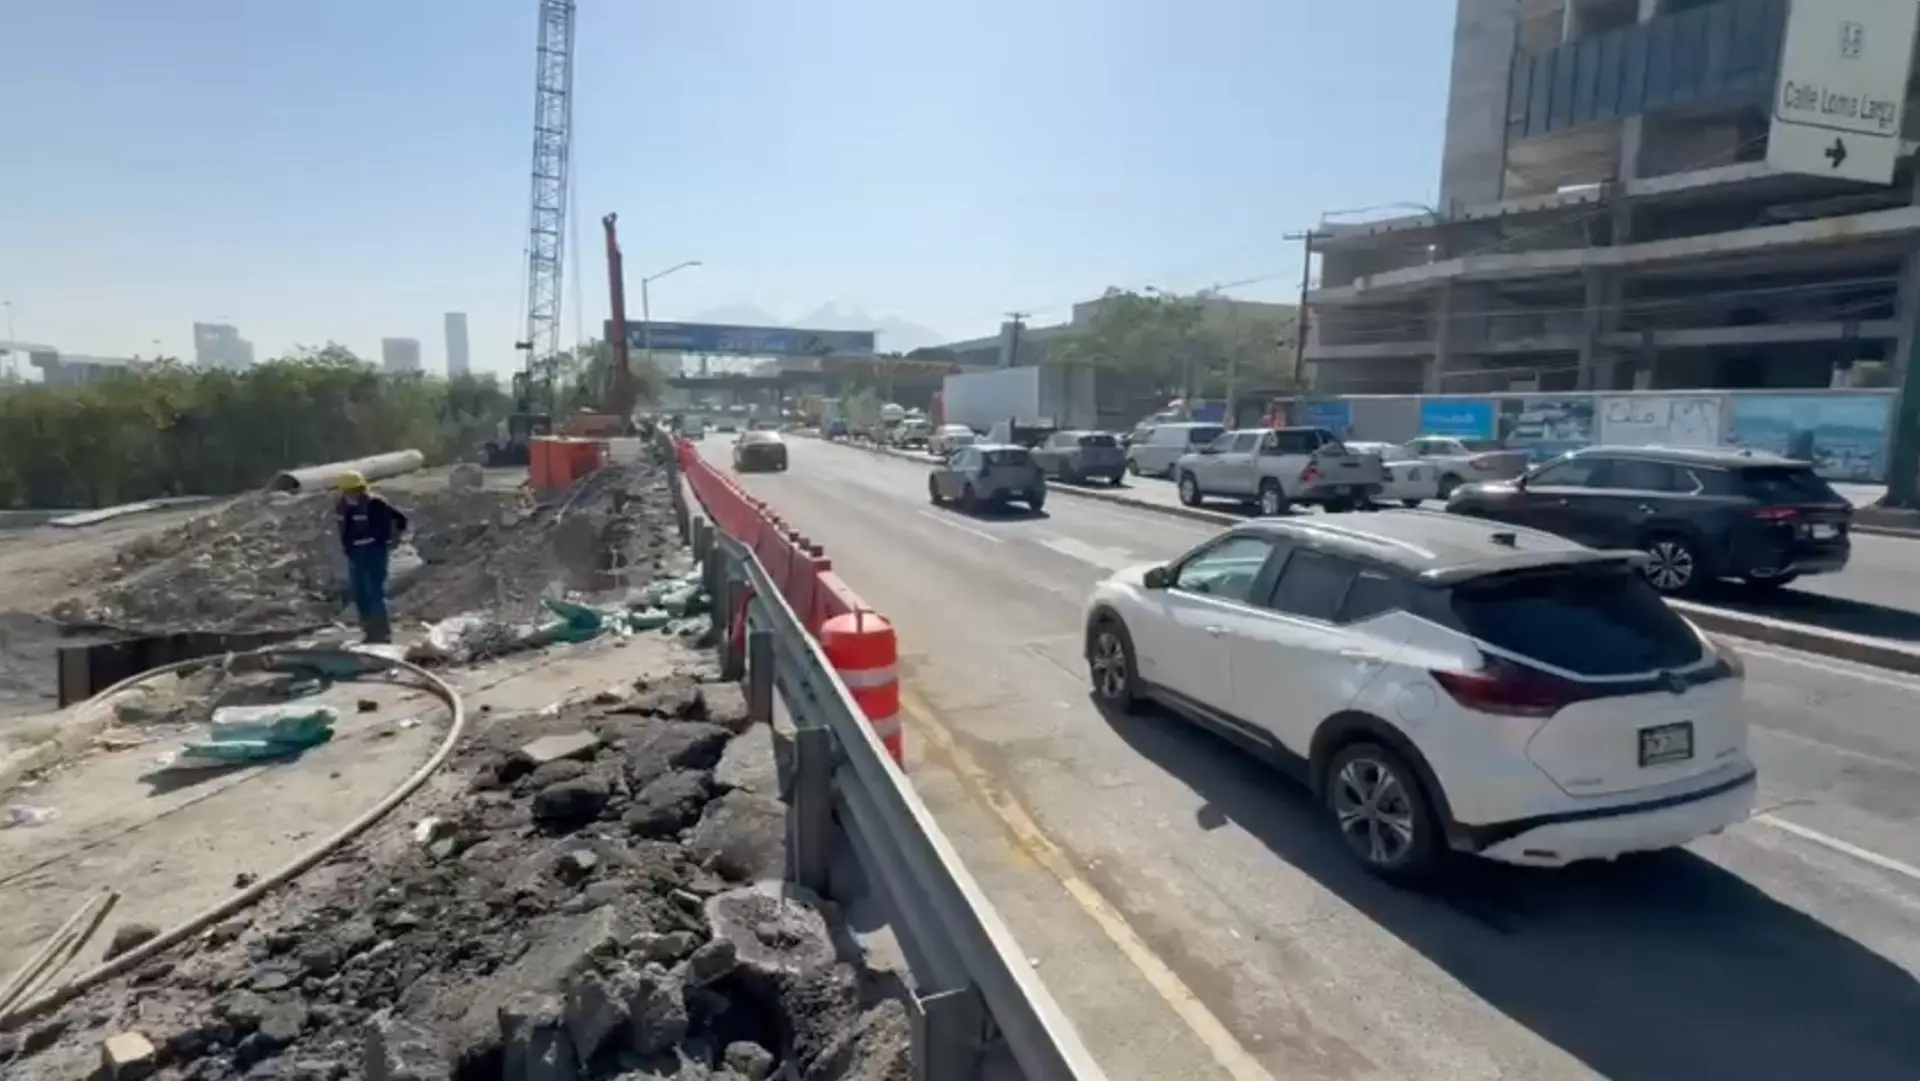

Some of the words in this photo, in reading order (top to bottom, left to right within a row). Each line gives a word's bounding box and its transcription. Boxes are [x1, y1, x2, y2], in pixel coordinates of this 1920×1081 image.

[1784, 80, 1818, 112] Calle
[1821, 85, 1858, 118] Loma
[1860, 93, 1897, 128] Larga
